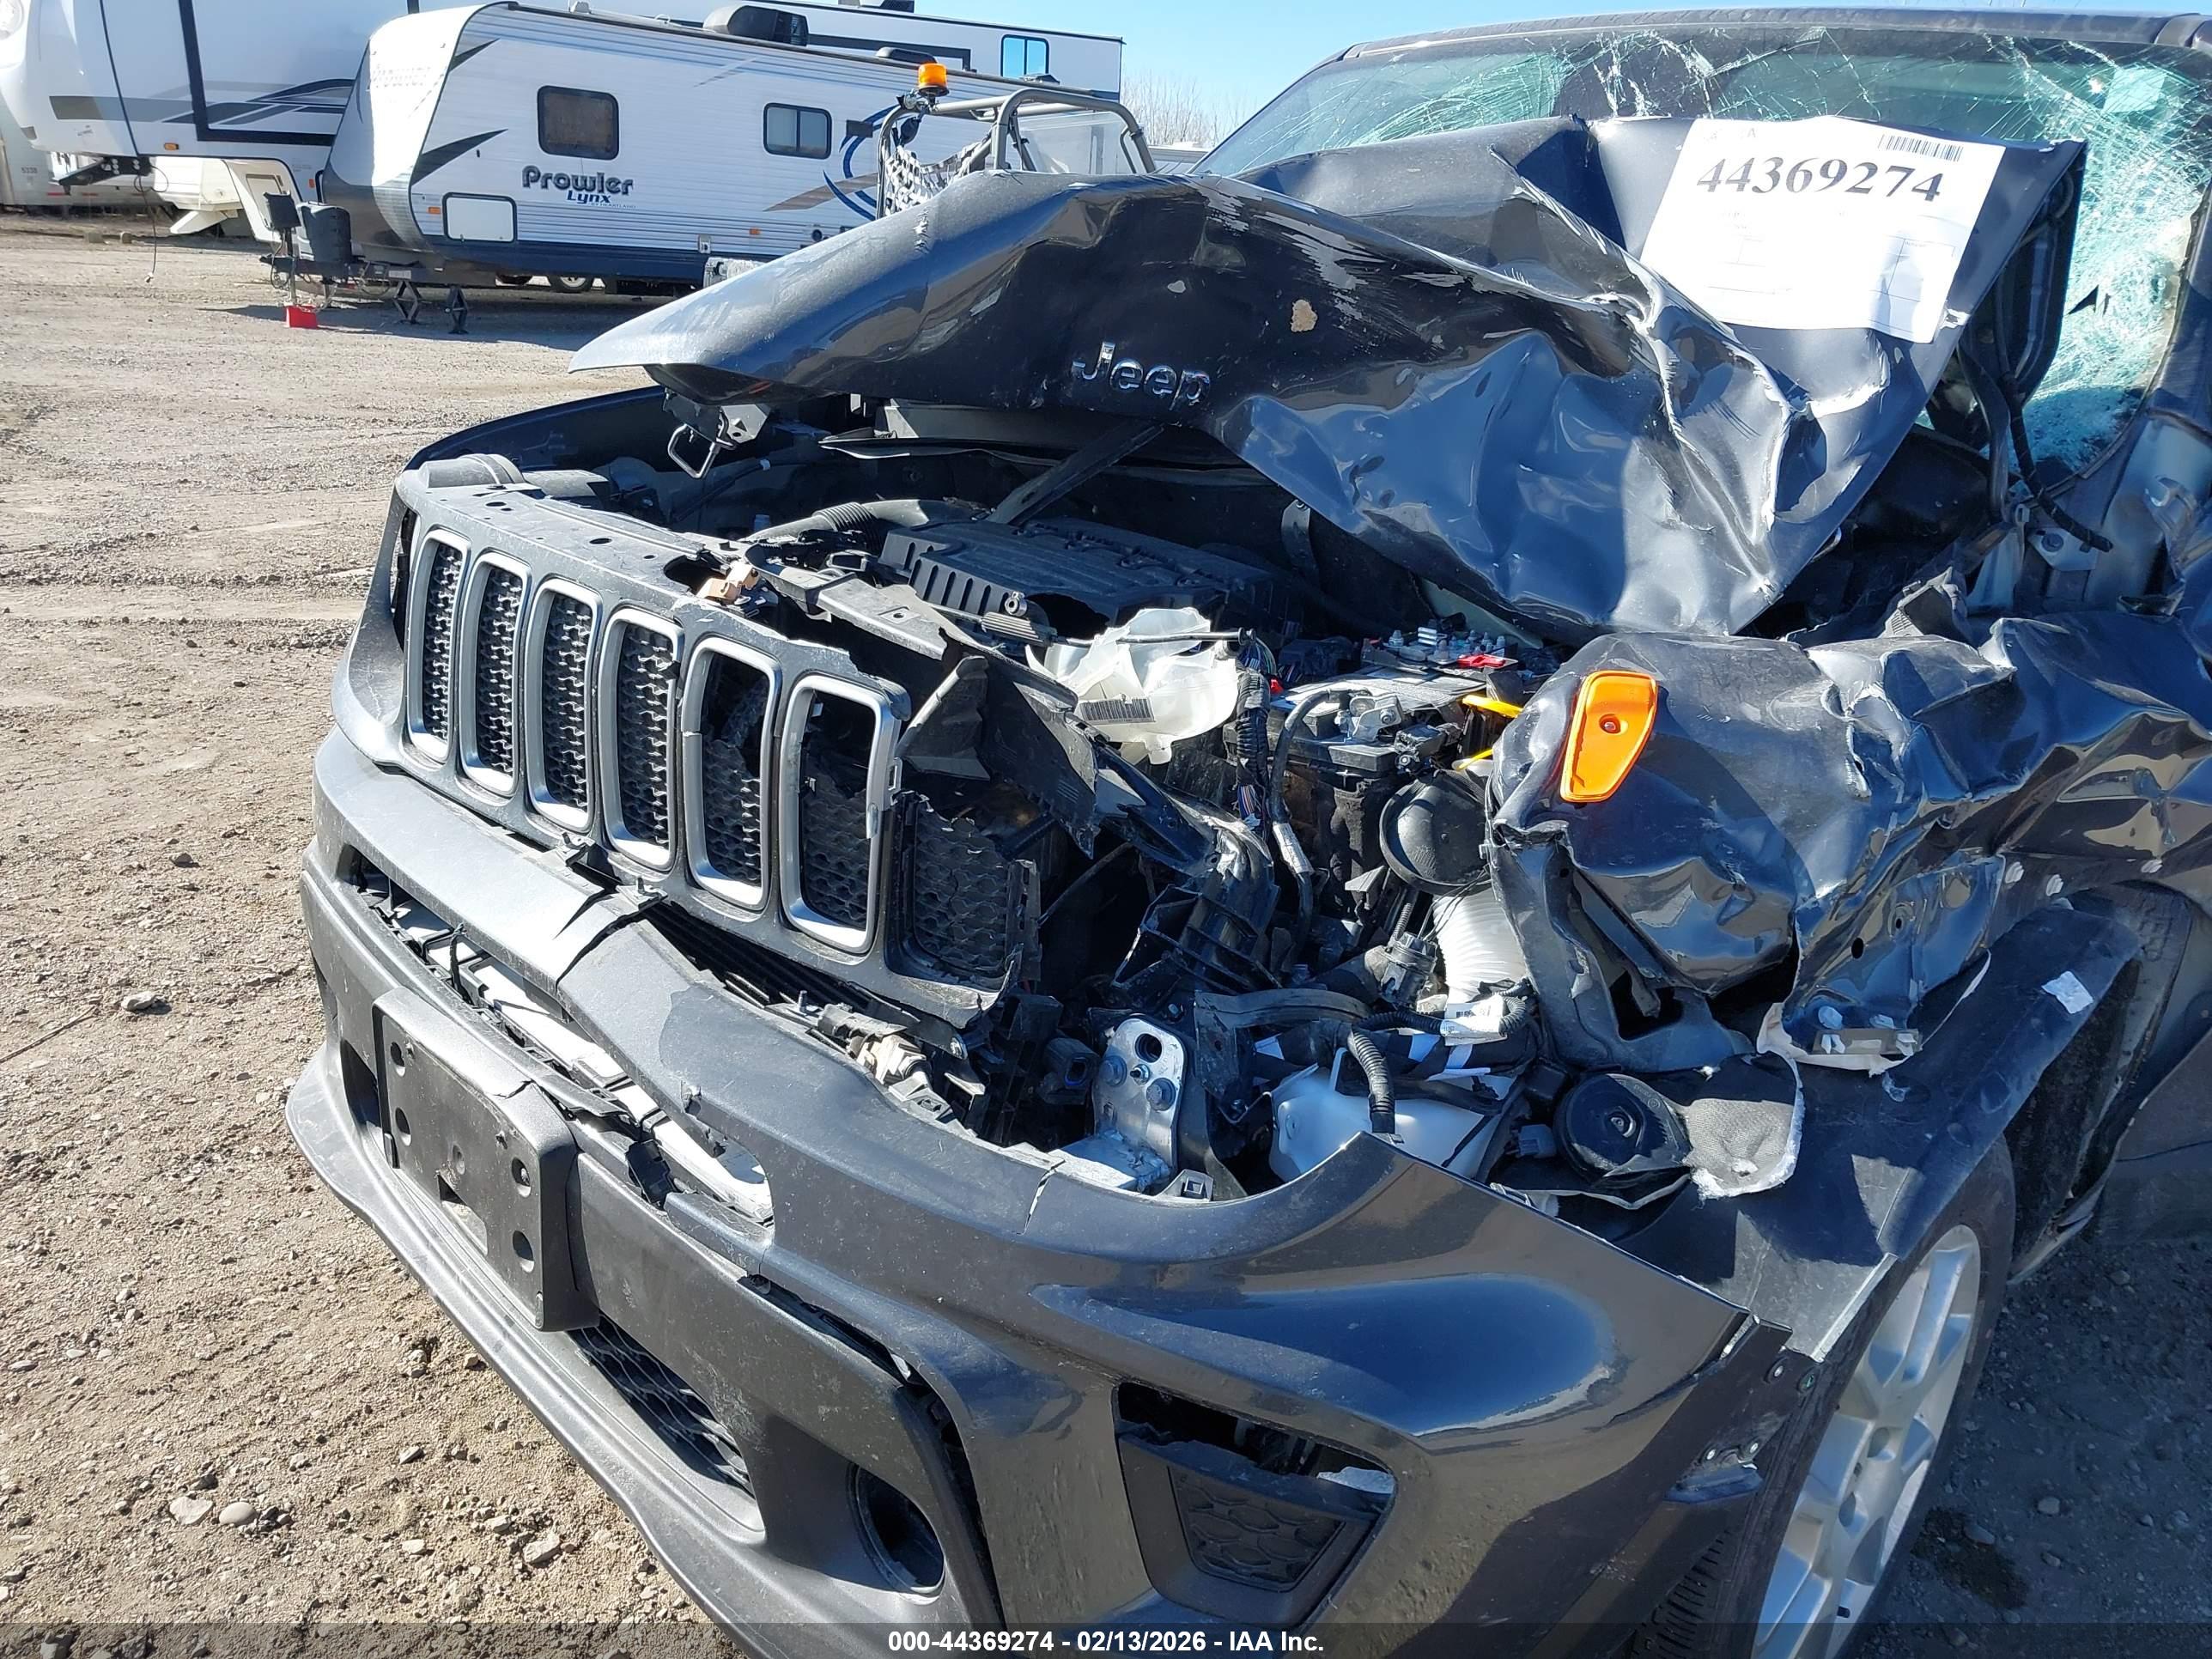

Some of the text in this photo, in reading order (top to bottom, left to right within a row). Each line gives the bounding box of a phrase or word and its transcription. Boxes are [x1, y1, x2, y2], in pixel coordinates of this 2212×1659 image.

[522, 165, 634, 196] Prowler
[567, 190, 611, 204] Lynx
[1697, 157, 1943, 202] 44369274
[1072, 342, 1211, 410] Jeep
